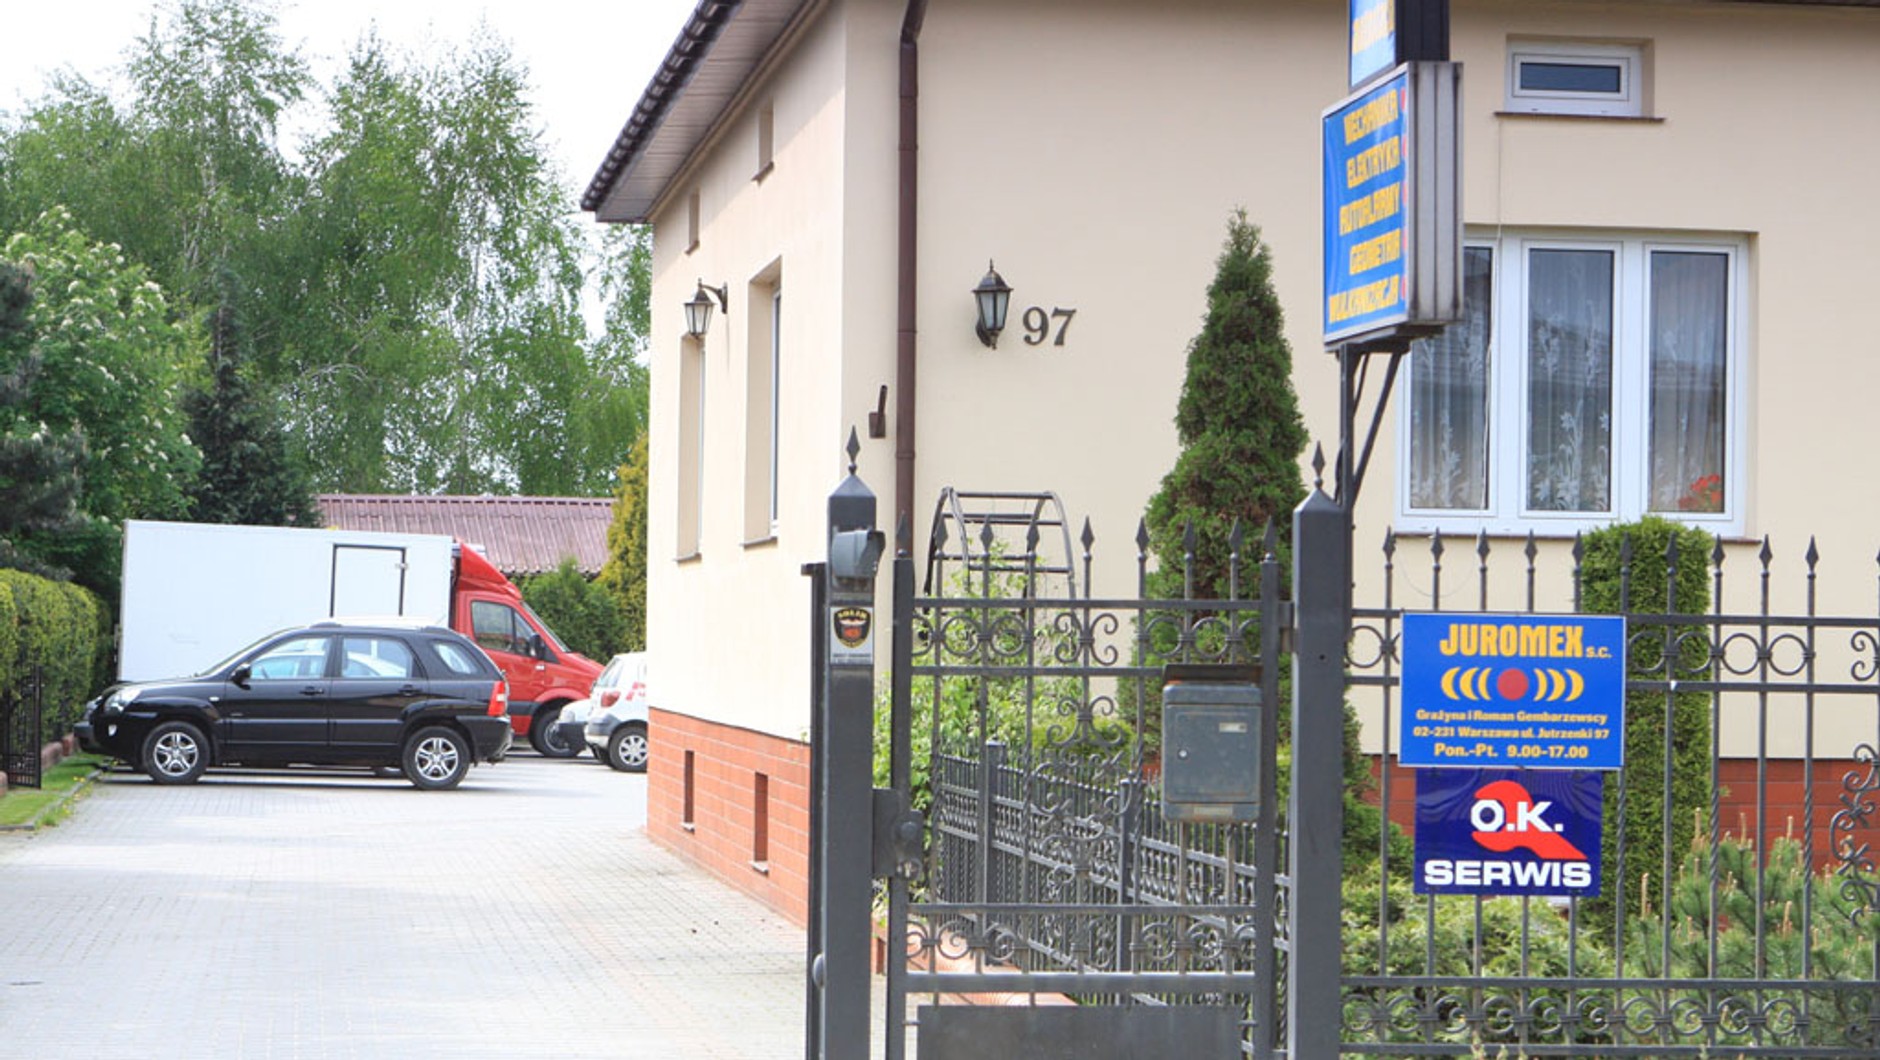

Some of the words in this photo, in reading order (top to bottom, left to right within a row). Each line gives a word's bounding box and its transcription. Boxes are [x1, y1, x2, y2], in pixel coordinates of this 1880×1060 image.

[1023, 306, 1077, 346] 97
[1439, 624, 1583, 658] JUROMEX
[1473, 710, 1514, 721] Roman
[1413, 726, 1455, 737] 02-231
[1458, 727, 1519, 738] Warszawa
[1538, 728, 1593, 739] Jutrzenki
[1594, 729, 1610, 739] 97
[1434, 743, 1498, 757] Pon.-Pt.
[1507, 745, 1589, 758] 9.00-17.00
[1471, 799, 1564, 832] O.K.
[1425, 860, 1592, 887] SERWIS
